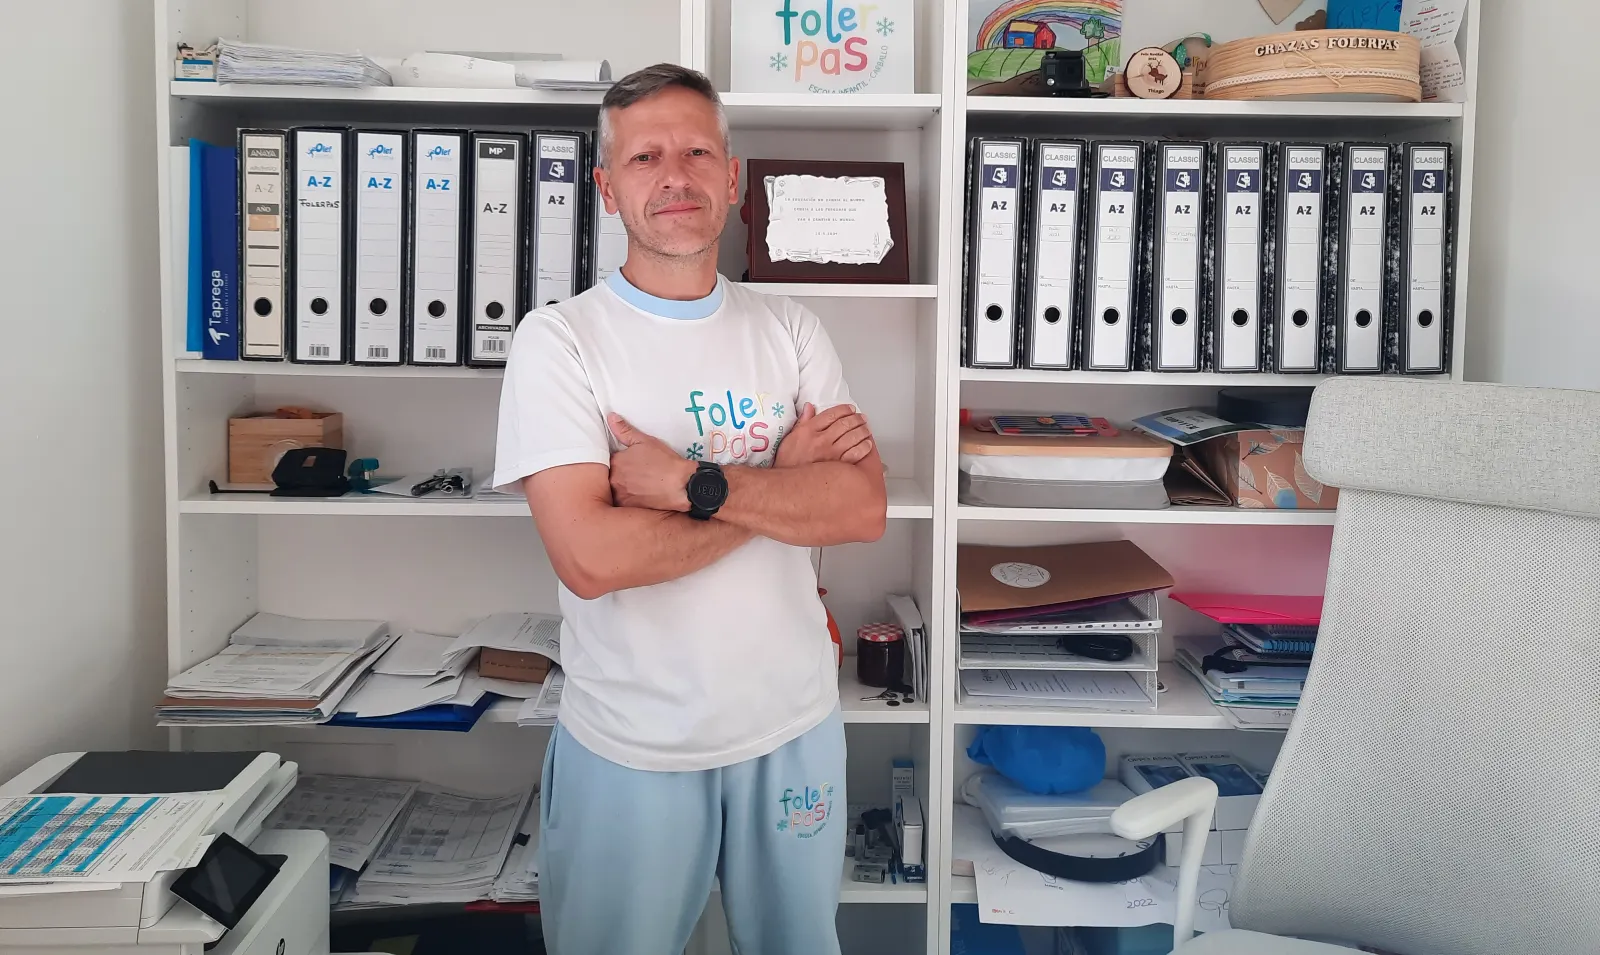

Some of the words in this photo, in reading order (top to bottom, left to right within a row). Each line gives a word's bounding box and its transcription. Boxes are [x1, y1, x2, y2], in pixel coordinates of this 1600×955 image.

[1254, 39, 1320, 57] GRAZAS
[1327, 36, 1400, 51] FOLERPAS
[795, 37, 868, 83] pas
[542, 145, 574, 154] CLASSIC
[307, 176, 332, 188] A-Z
[367, 177, 392, 189] A-Z
[425, 178, 450, 190] A-Z
[298, 198, 340, 208] FOLERPAS
[548, 195, 565, 205] A-Z
[483, 203, 508, 214] A-Z
[209, 270, 225, 326] Taprega
[685, 390, 771, 437] foler
[708, 422, 769, 461] pas
[779, 782, 828, 817] foler
[791, 802, 826, 830] pas
[1127, 899, 1158, 908] 2022
